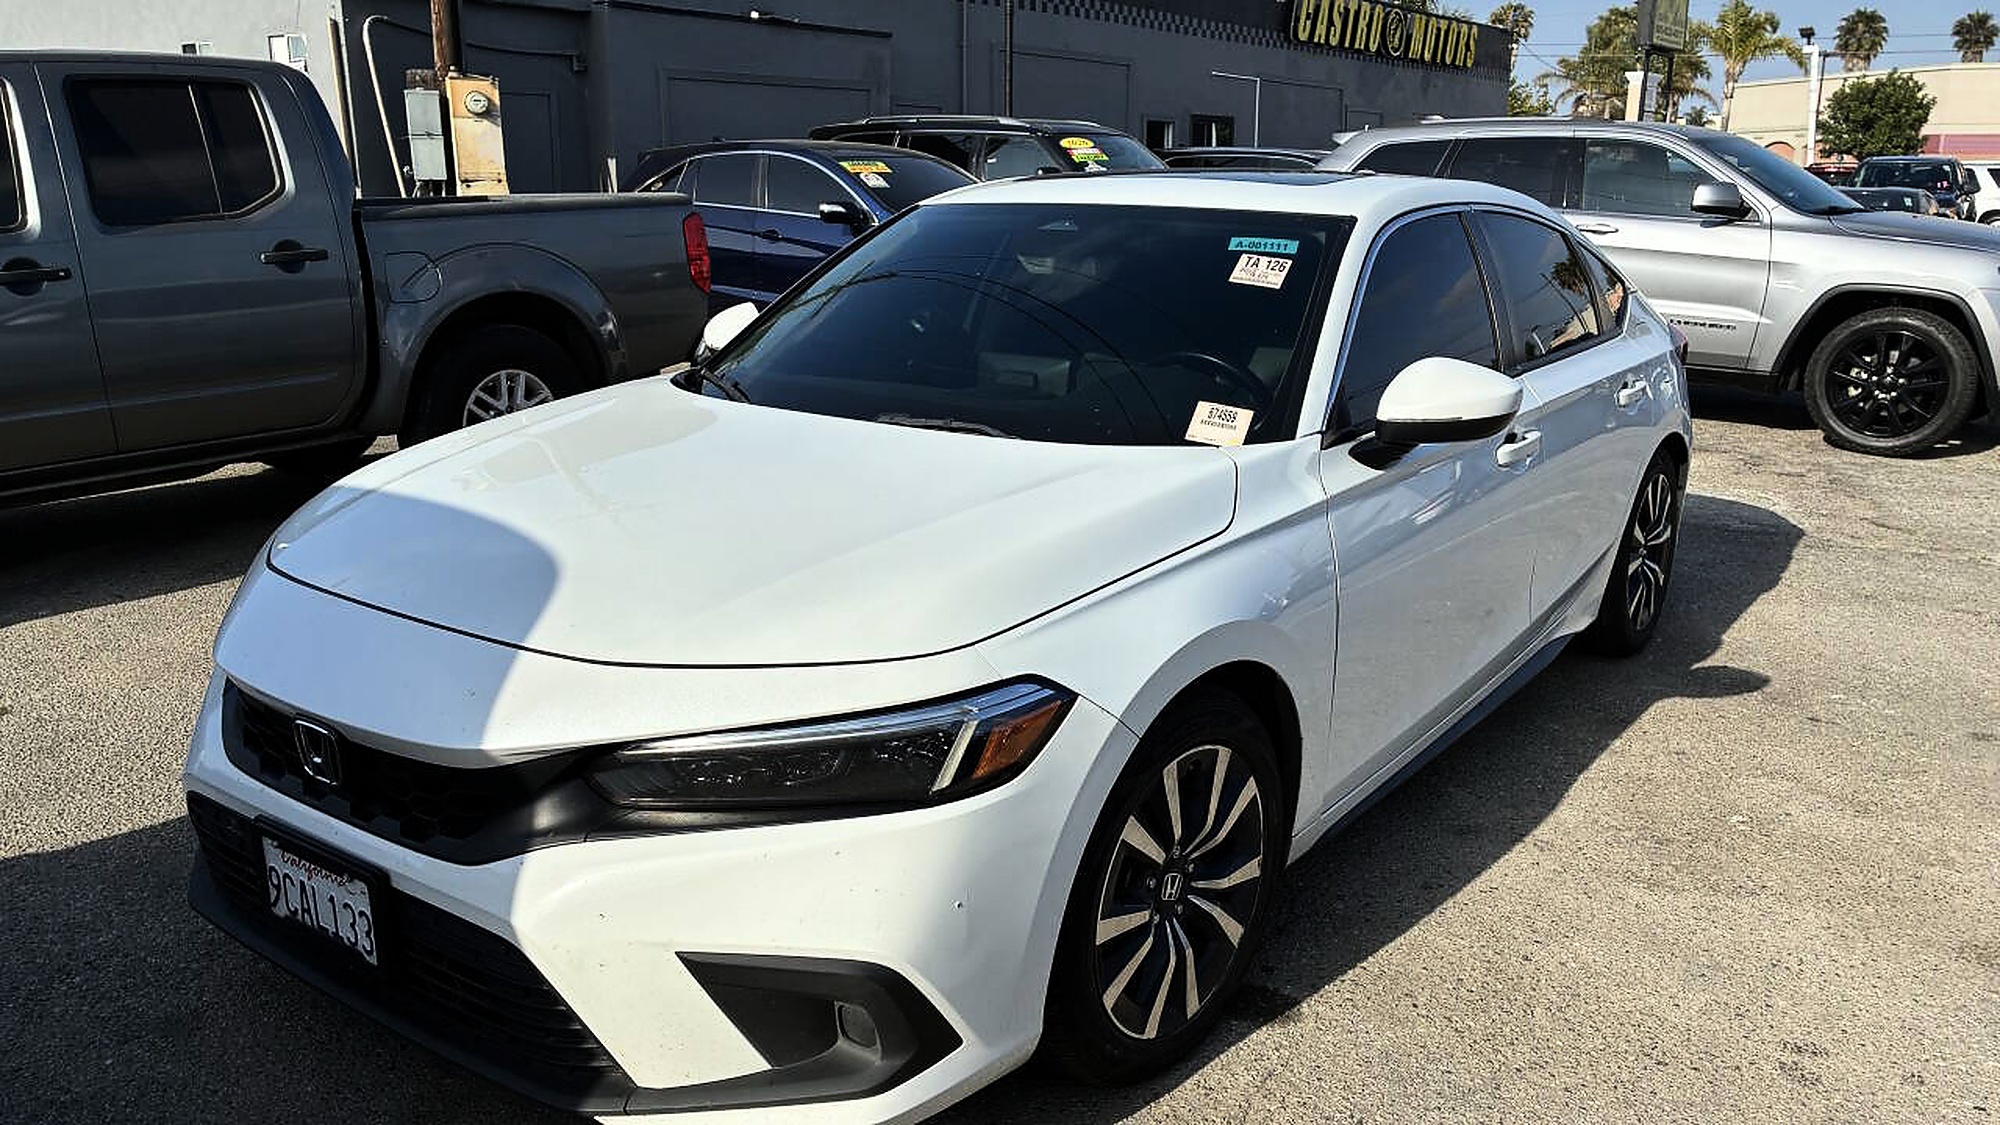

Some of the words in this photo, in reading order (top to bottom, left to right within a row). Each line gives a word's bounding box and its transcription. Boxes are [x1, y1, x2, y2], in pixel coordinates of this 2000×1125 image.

[1298, 0, 1385, 52] CASTRO
[1408, 13, 1478, 68] MOTORS
[1245, 255, 1260, 268] TA
[1266, 259, 1288, 272] 126
[268, 865, 374, 956] 9CAL133
